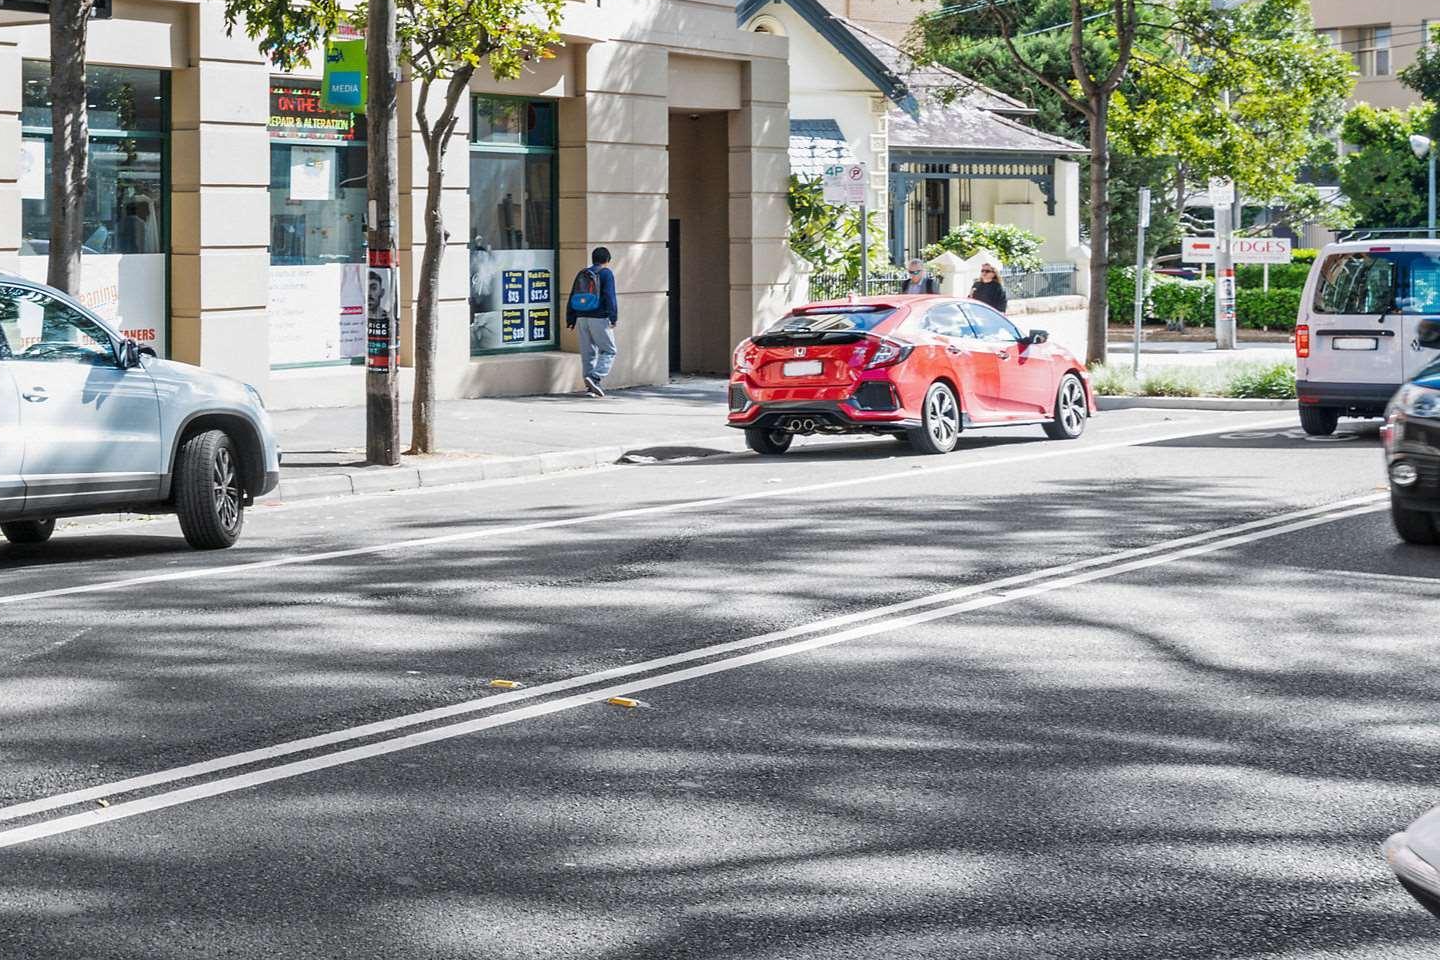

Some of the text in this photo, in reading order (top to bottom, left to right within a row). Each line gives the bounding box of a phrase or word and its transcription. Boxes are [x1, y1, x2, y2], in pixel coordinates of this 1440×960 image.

[331, 84, 359, 93] MEDIA
[278, 97, 316, 112] ON THE
[825, 166, 844, 177] 4P
[1231, 241, 1286, 253] DGES
